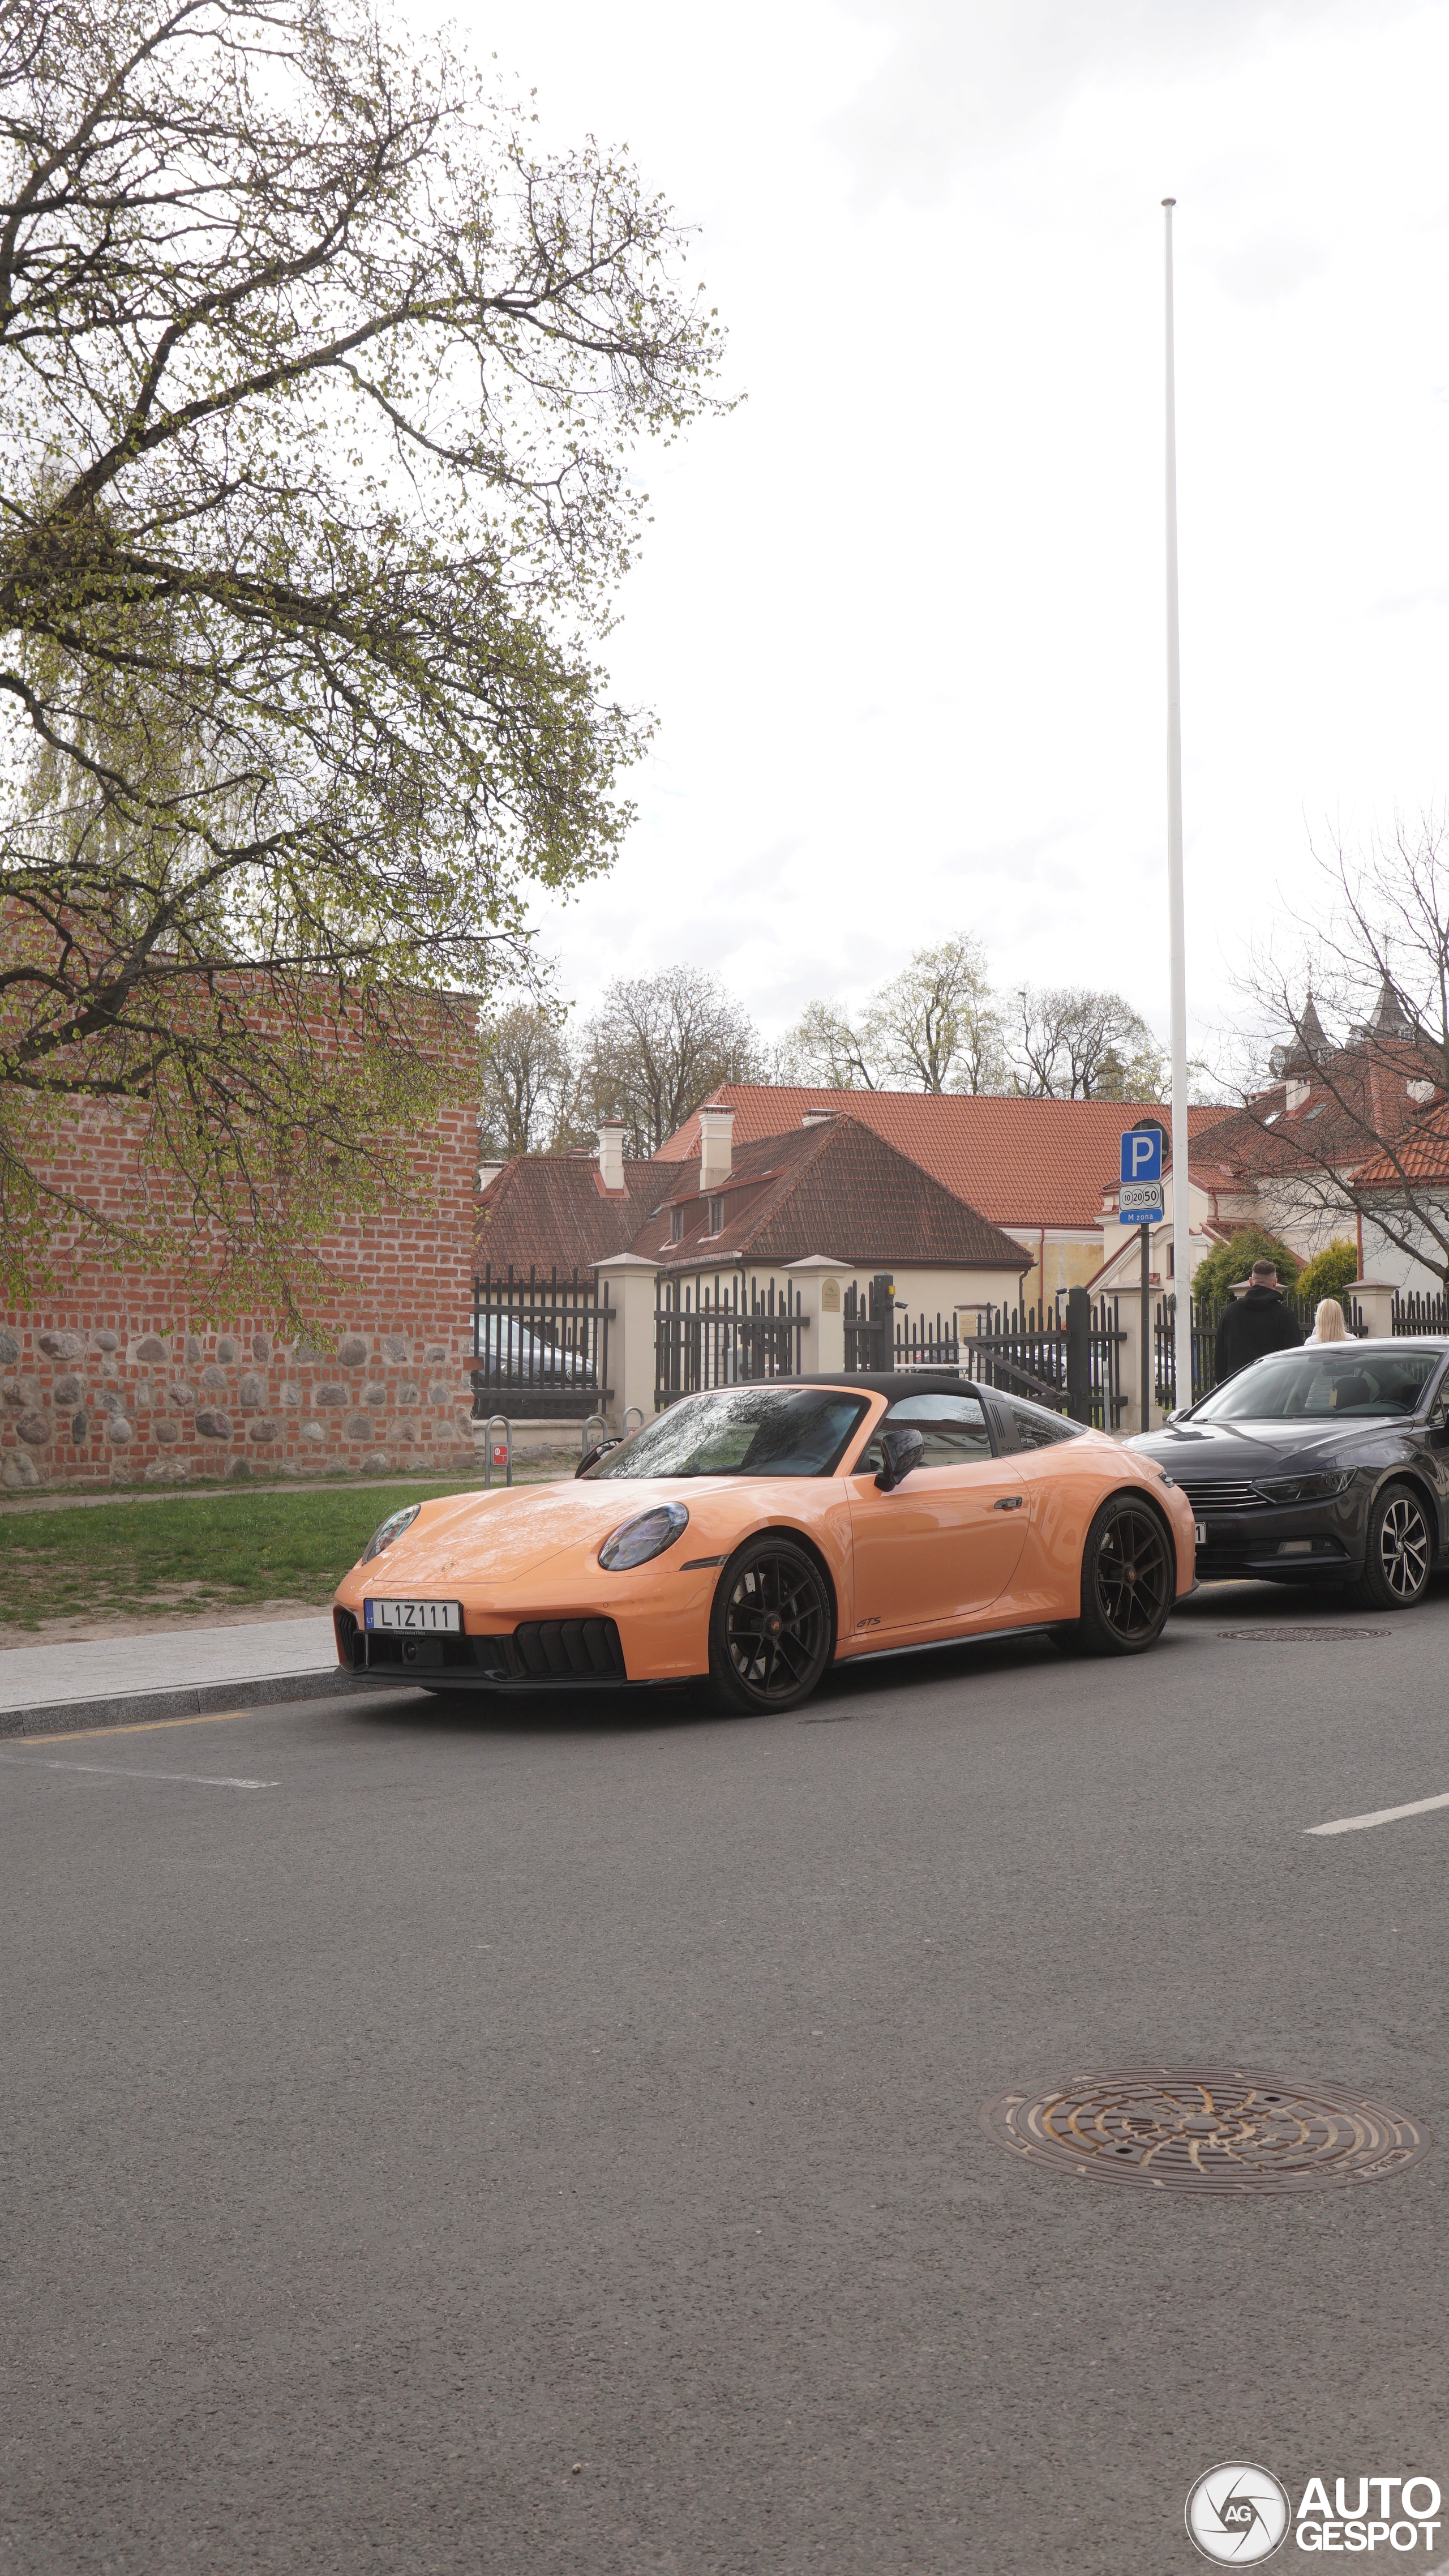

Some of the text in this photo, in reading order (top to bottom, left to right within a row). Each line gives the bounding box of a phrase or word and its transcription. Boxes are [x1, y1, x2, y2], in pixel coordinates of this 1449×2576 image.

[1132, 1136, 1154, 1177] P
[1133, 1193, 1142, 1201] 20
[1144, 1191, 1156, 1201] 50
[381, 1604, 448, 1628] L1Z111
[856, 1616, 881, 1627] GTS
